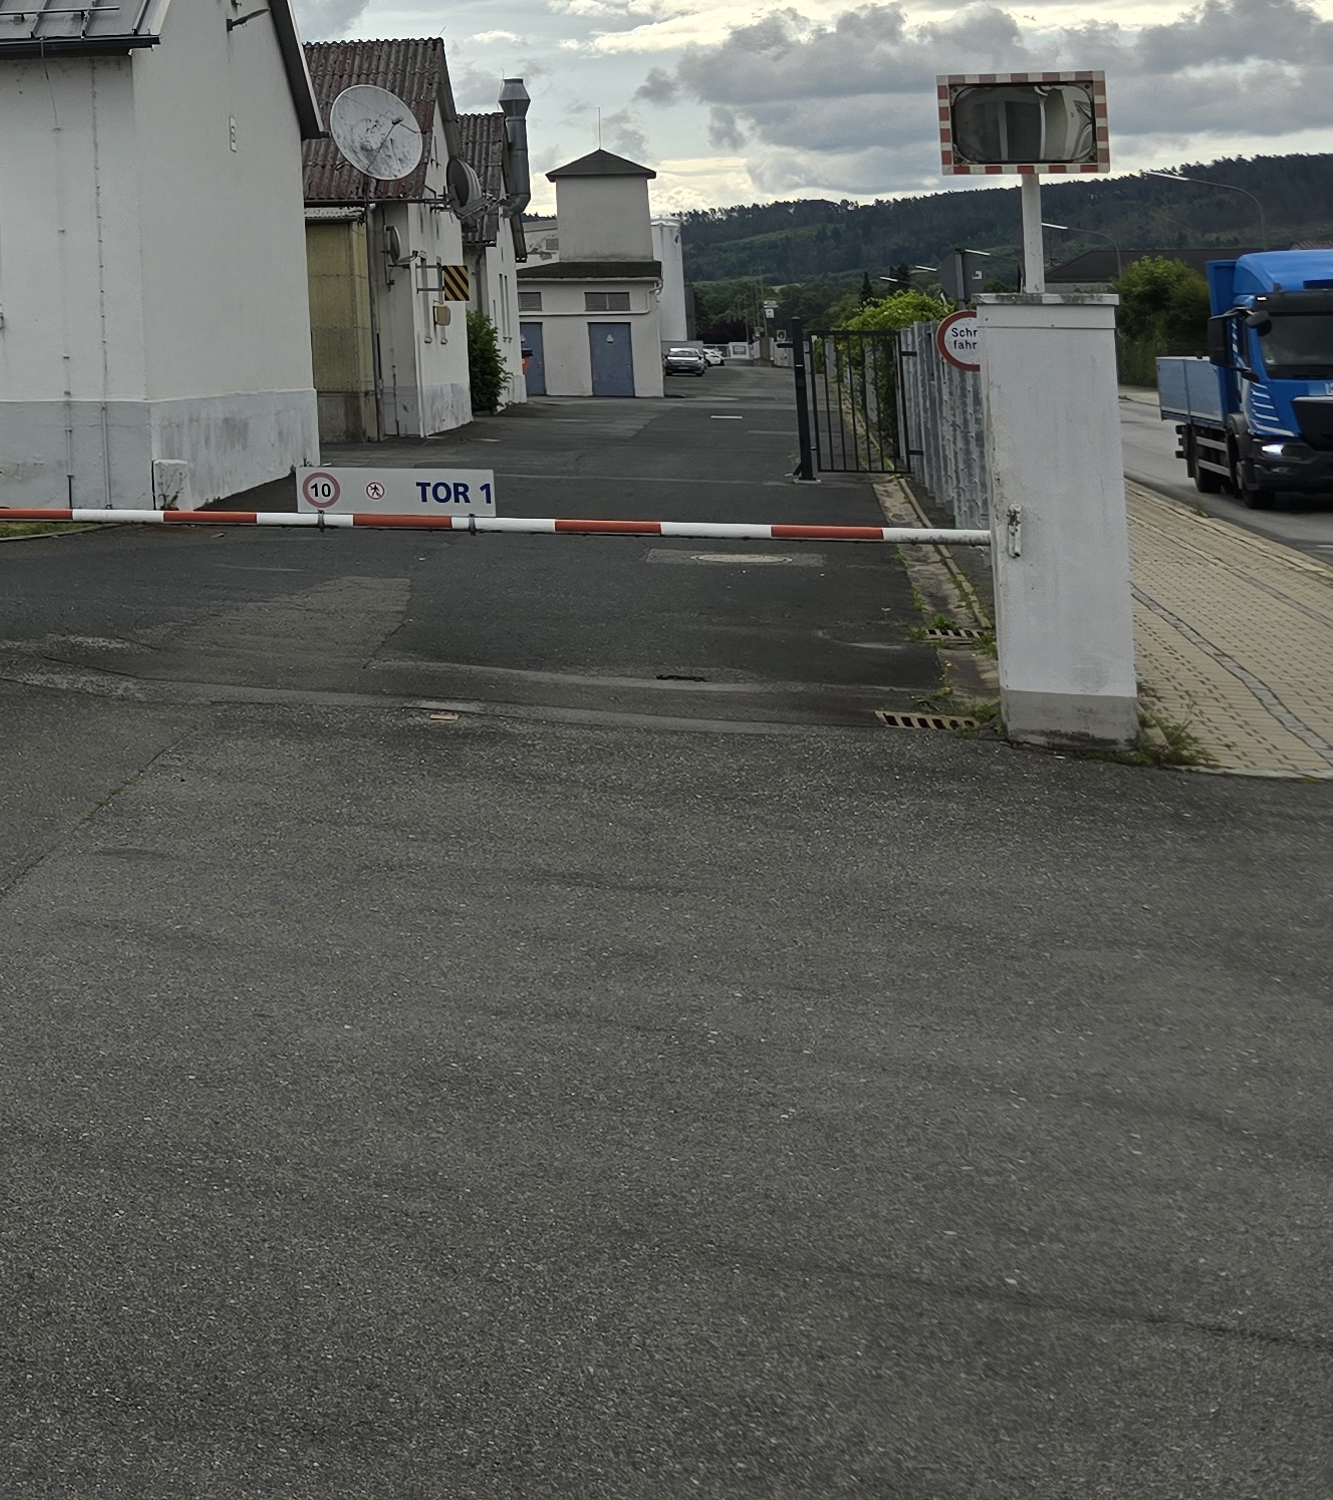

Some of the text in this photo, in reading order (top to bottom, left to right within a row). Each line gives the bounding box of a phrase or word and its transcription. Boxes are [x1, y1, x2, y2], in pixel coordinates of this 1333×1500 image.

[951, 327, 978, 338] Schr
[953, 340, 977, 350] fahr
[310, 483, 331, 498] 10
[415, 482, 492, 504] TOR 1
